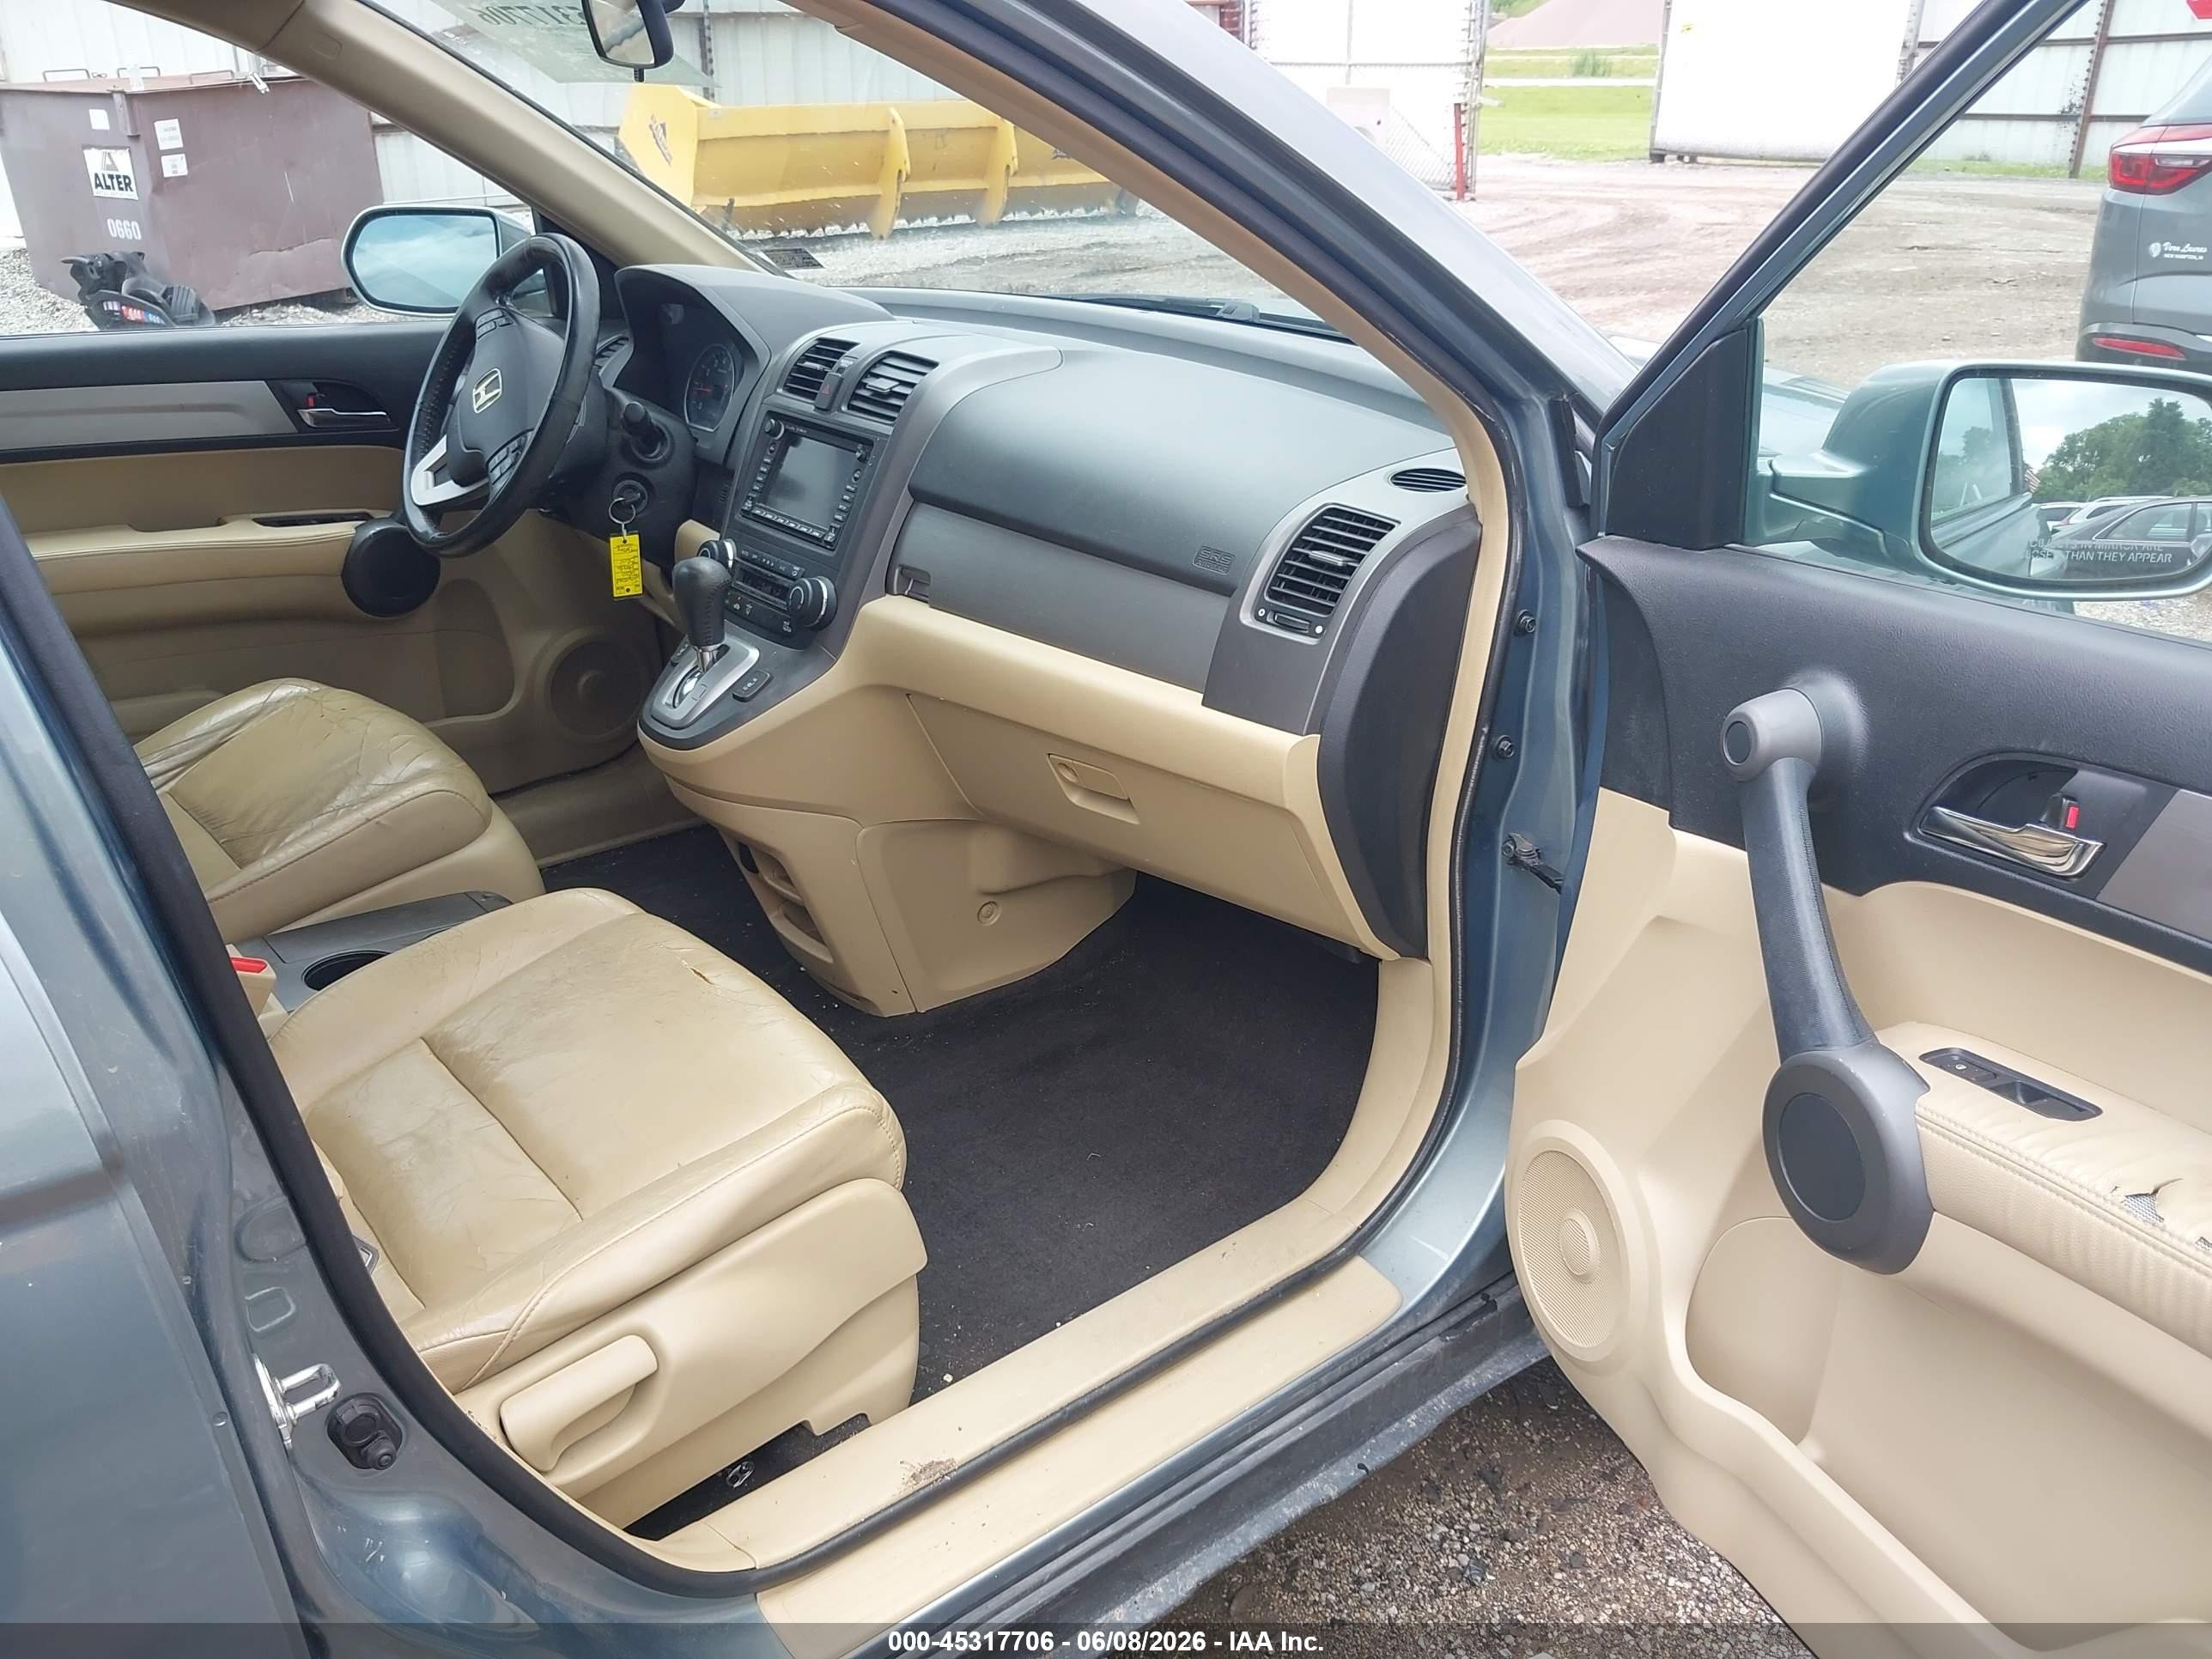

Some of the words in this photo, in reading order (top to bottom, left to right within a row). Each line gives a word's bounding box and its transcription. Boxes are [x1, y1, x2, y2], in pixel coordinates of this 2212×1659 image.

[94, 172, 134, 192] ALTER
[106, 218, 142, 240] 0660
[2065, 550, 2094, 561] THAN
[2096, 551, 2127, 562] THEY
[2127, 552, 2172, 563] APPEAR
